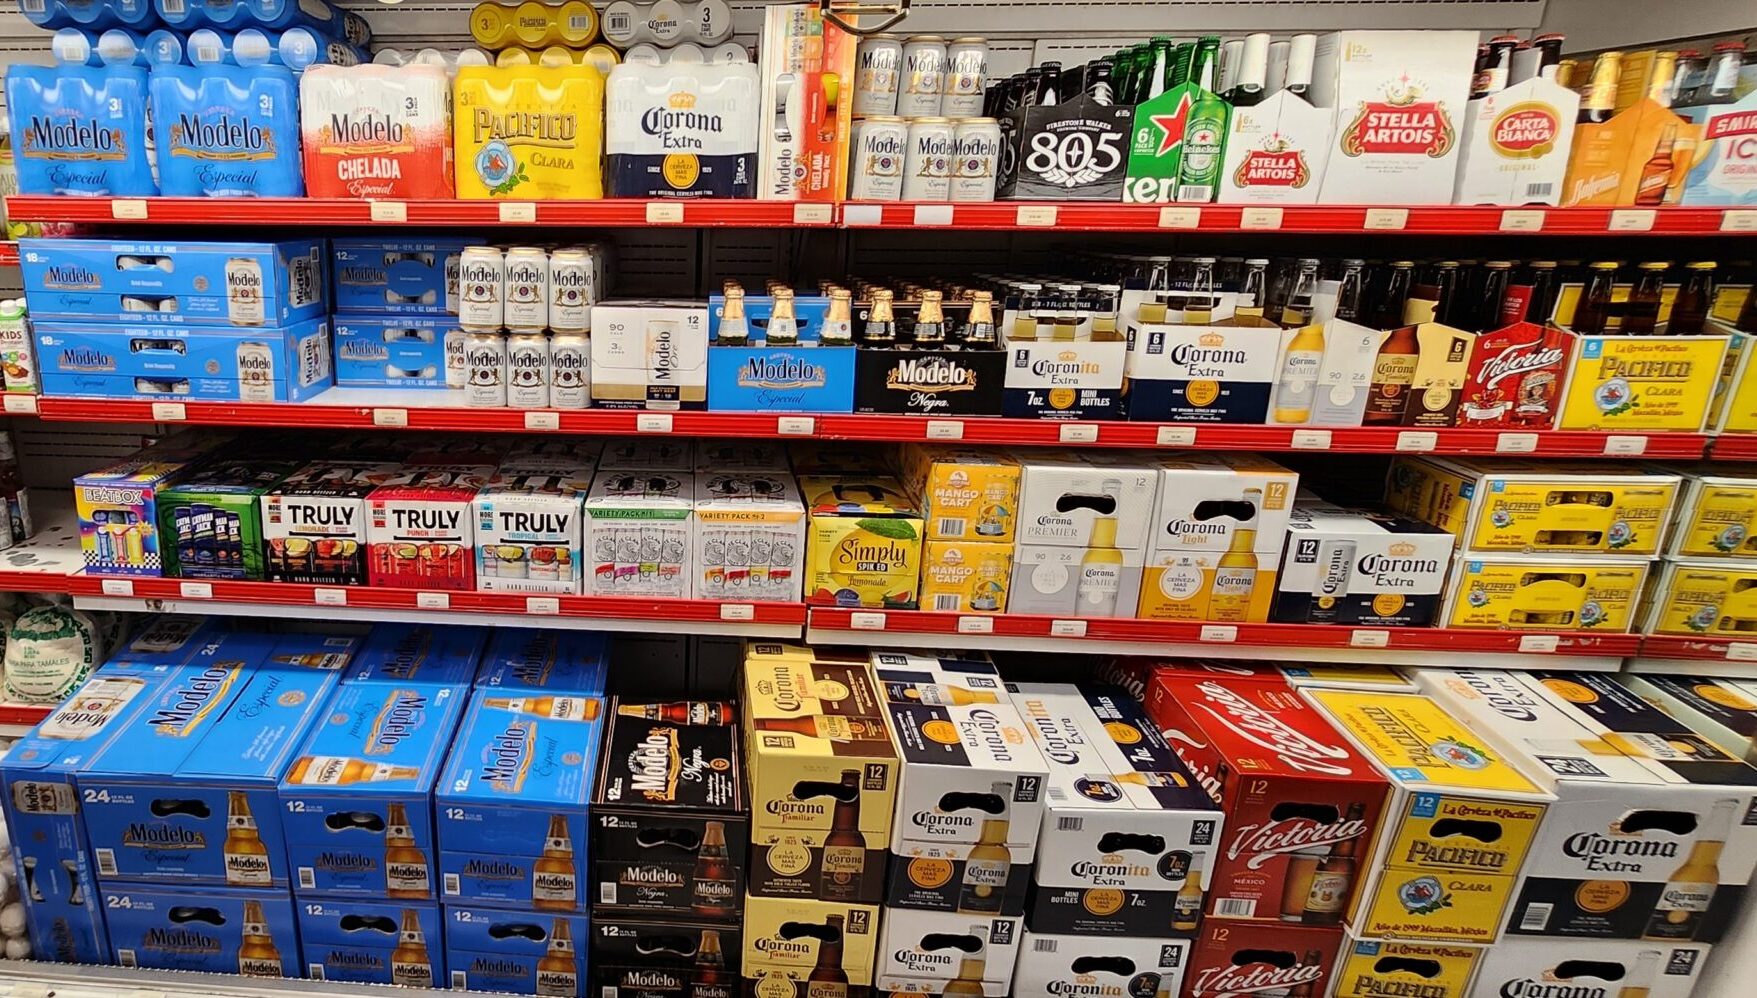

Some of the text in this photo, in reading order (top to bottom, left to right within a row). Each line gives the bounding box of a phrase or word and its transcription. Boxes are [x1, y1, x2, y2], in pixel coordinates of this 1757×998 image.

[703, 8, 711, 22] 3
[108, 98, 118, 112] 3
[405, 97, 414, 110] 3
[473, 107, 577, 143] PACIFICO
[641, 106, 723, 138] Corona
[1086, 119, 1112, 130] WALKER
[1367, 112, 1436, 128] STELLA
[1502, 117, 1550, 131] CARTA
[32, 116, 112, 151] Modelo
[179, 113, 262, 151] Modelo
[331, 113, 403, 143] Modelo
[1137, 128, 1149, 142] 6
[662, 132, 702, 149] Extra
[1363, 128, 1434, 144] ARTOIS
[1025, 132, 1123, 173] 805
[530, 152, 575, 170] CLARA
[1250, 158, 1296, 169] STELLA
[47, 164, 107, 187] Especial
[198, 165, 258, 187] Especial
[337, 159, 401, 180] CHELADA
[811, 151, 823, 190] CHELADA
[1248, 168, 1295, 180] ARTOIS
[25, 252, 39, 263] 18
[336, 251, 348, 260] 12
[50, 266, 94, 284] Modelo
[228, 271, 261, 287] Modelo
[462, 265, 500, 282] Modelo
[507, 266, 544, 282] Modelo
[553, 270, 591, 286] Modelo
[687, 316, 698, 324] 12
[336, 327, 348, 336] 12
[40, 335, 53, 346] 18
[1153, 334, 1160, 344] 6
[1362, 336, 1370, 346] 6
[1588, 342, 1597, 351] 6
[1171, 344, 1246, 366] Corona
[1289, 356, 1317, 366] Corona
[749, 357, 814, 380] Modelo
[1032, 360, 1099, 378] Coronita
[1185, 364, 1224, 377] Extra
[1478, 338, 1564, 389] Victoria
[1598, 356, 1692, 380] PACIFICO
[898, 359, 967, 384] Modelo
[1329, 372, 1341, 380] 90
[1051, 375, 1078, 384] Extra
[757, 389, 804, 407] Especial
[1081, 390, 1097, 398] MINI
[1645, 387, 1682, 396] CLARA
[1080, 398, 1110, 406] BOTTLES
[84, 488, 143, 504] BEATBOX
[935, 489, 979, 498] MANGO
[941, 498, 972, 507] CART
[192, 513, 213, 525] CAYMAN
[288, 505, 354, 525] TRULY
[393, 509, 460, 529] TRULY
[480, 511, 494, 519] MORE
[591, 510, 640, 518] VARIETY PACK
[1037, 516, 1072, 526] Corona
[195, 521, 212, 532] JACK
[500, 512, 569, 533] TRULY
[1167, 520, 1226, 538] Corona
[508, 532, 539, 540] TROPICAL
[1028, 527, 1078, 537] PREMIER
[1182, 534, 1208, 545] Light
[839, 539, 907, 568] Simply
[930, 566, 972, 575] MANGO
[1357, 553, 1438, 575] Corona
[1085, 568, 1115, 578] Corona
[1322, 549, 1343, 594] Corona
[848, 576, 886, 587] Lemonade
[1373, 574, 1414, 587] Extra
[773, 666, 801, 712] Corona
[147, 668, 228, 728] Modelo
[379, 696, 427, 746] Modelo
[1190, 680, 1352, 775] Victoria
[1396, 708, 1430, 733] CLARA
[960, 721, 978, 747] Extra
[969, 709, 1012, 763] Corona
[1025, 700, 1080, 765] Coronita
[1359, 706, 1451, 769] PACIFICO
[480, 727, 526, 784] Modelo
[631, 735, 669, 791] Modelo
[868, 766, 883, 779] 12
[1022, 778, 1036, 790] 12
[1250, 780, 1268, 794] 12
[84, 789, 110, 803] 24
[286, 801, 305, 812] 12
[766, 800, 824, 815] Corona
[1443, 804, 1492, 818] La Cerveza
[446, 808, 464, 820] 12
[130, 823, 195, 844] Modelo
[925, 825, 956, 835] Extra
[1196, 822, 1210, 834] 24
[1226, 817, 1367, 869] Victoria
[1563, 832, 1678, 861] Corona
[322, 852, 370, 867] Modelo
[1406, 840, 1508, 868] PACIFICO
[1071, 861, 1150, 876] Coronita
[1584, 856, 1641, 873] Extra
[627, 866, 677, 883] Modelo
[1234, 878, 1265, 886] MÉXICO
[1448, 880, 1492, 892] CLARA
[107, 896, 132, 908] 24
[1050, 896, 1078, 904] BOTTLES
[1666, 890, 1709, 902] Corona
[306, 904, 322, 915] 12
[601, 926, 618, 936] 12
[996, 923, 1009, 933] 12
[150, 928, 211, 947] Modelo
[754, 938, 809, 953] Corona
[1163, 947, 1178, 958] 24
[769, 951, 800, 960] Familiar
[1674, 951, 1693, 963] 24
[908, 962, 935, 972] Extra
[1046, 979, 1121, 995] Coronita
[1192, 962, 1324, 998] Victoria
